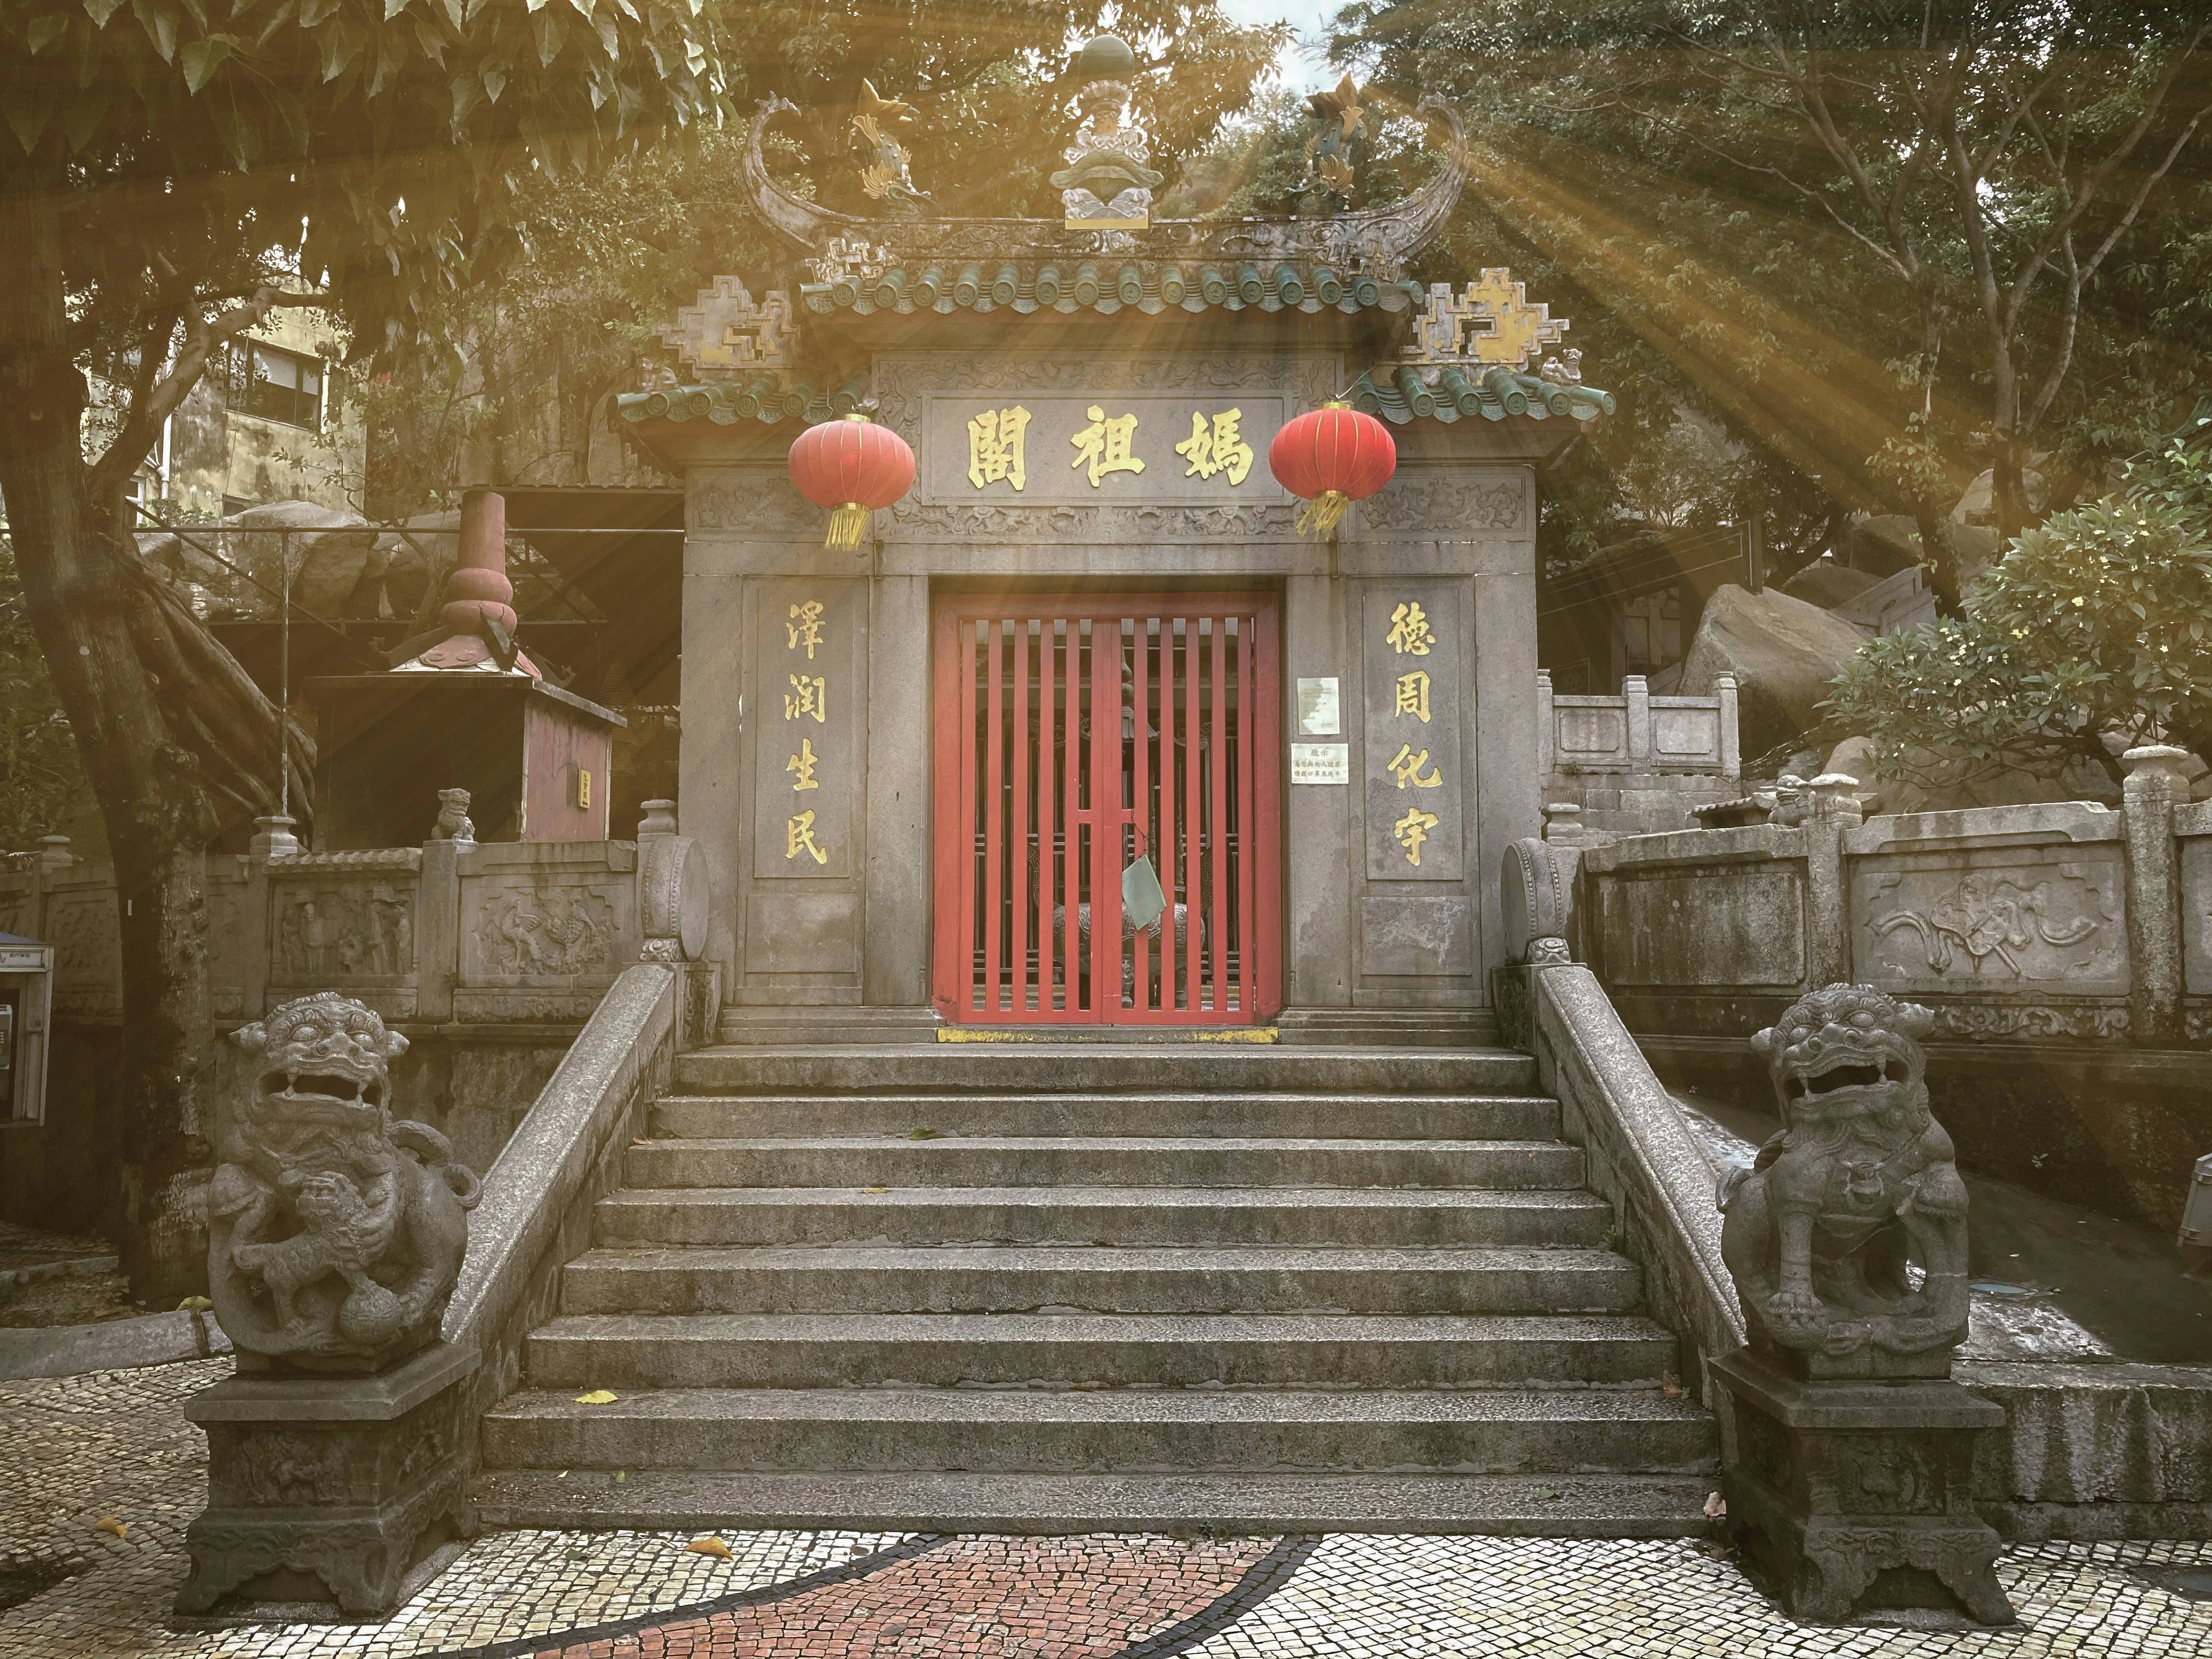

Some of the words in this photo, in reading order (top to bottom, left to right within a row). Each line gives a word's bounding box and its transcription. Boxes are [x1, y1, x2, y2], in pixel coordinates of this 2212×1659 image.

[784, 600, 828, 865] 澤潤生民
[1385, 601, 1443, 866] 德周化宇
